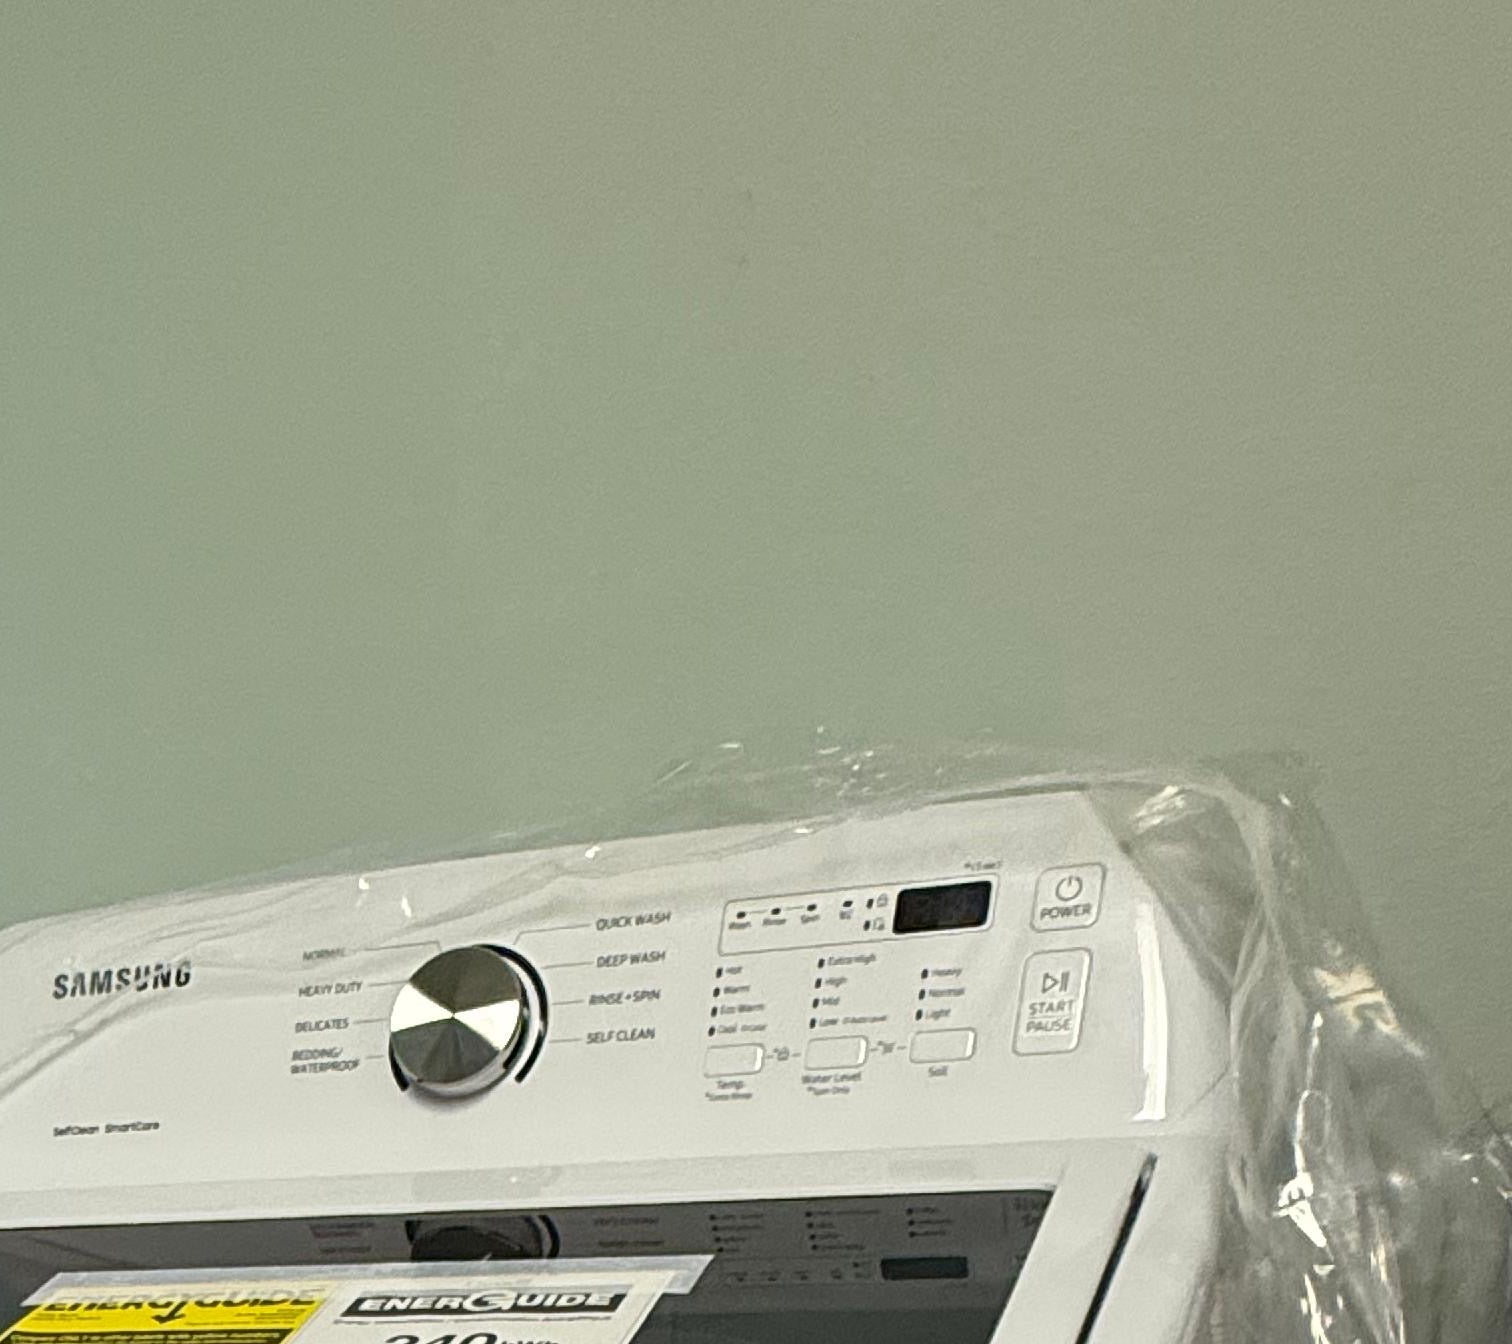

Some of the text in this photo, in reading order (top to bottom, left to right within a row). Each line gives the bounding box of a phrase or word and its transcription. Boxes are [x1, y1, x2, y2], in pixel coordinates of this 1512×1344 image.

[596, 911, 671, 931] QUICK WASH
[1039, 903, 1092, 921] POWER
[596, 950, 666, 968] DEEP WASH
[52, 959, 192, 1000] SAMSUNG
[298, 980, 363, 998] HEAVY DUTY
[632, 988, 661, 1003] SPIN
[1028, 999, 1073, 1016] START
[294, 1017, 350, 1033] DELICATES
[1026, 1018, 1073, 1033] PAUSE
[587, 1027, 657, 1044] SELF CLEAN
[359, 1289, 612, 1313] ENERGUIDE
